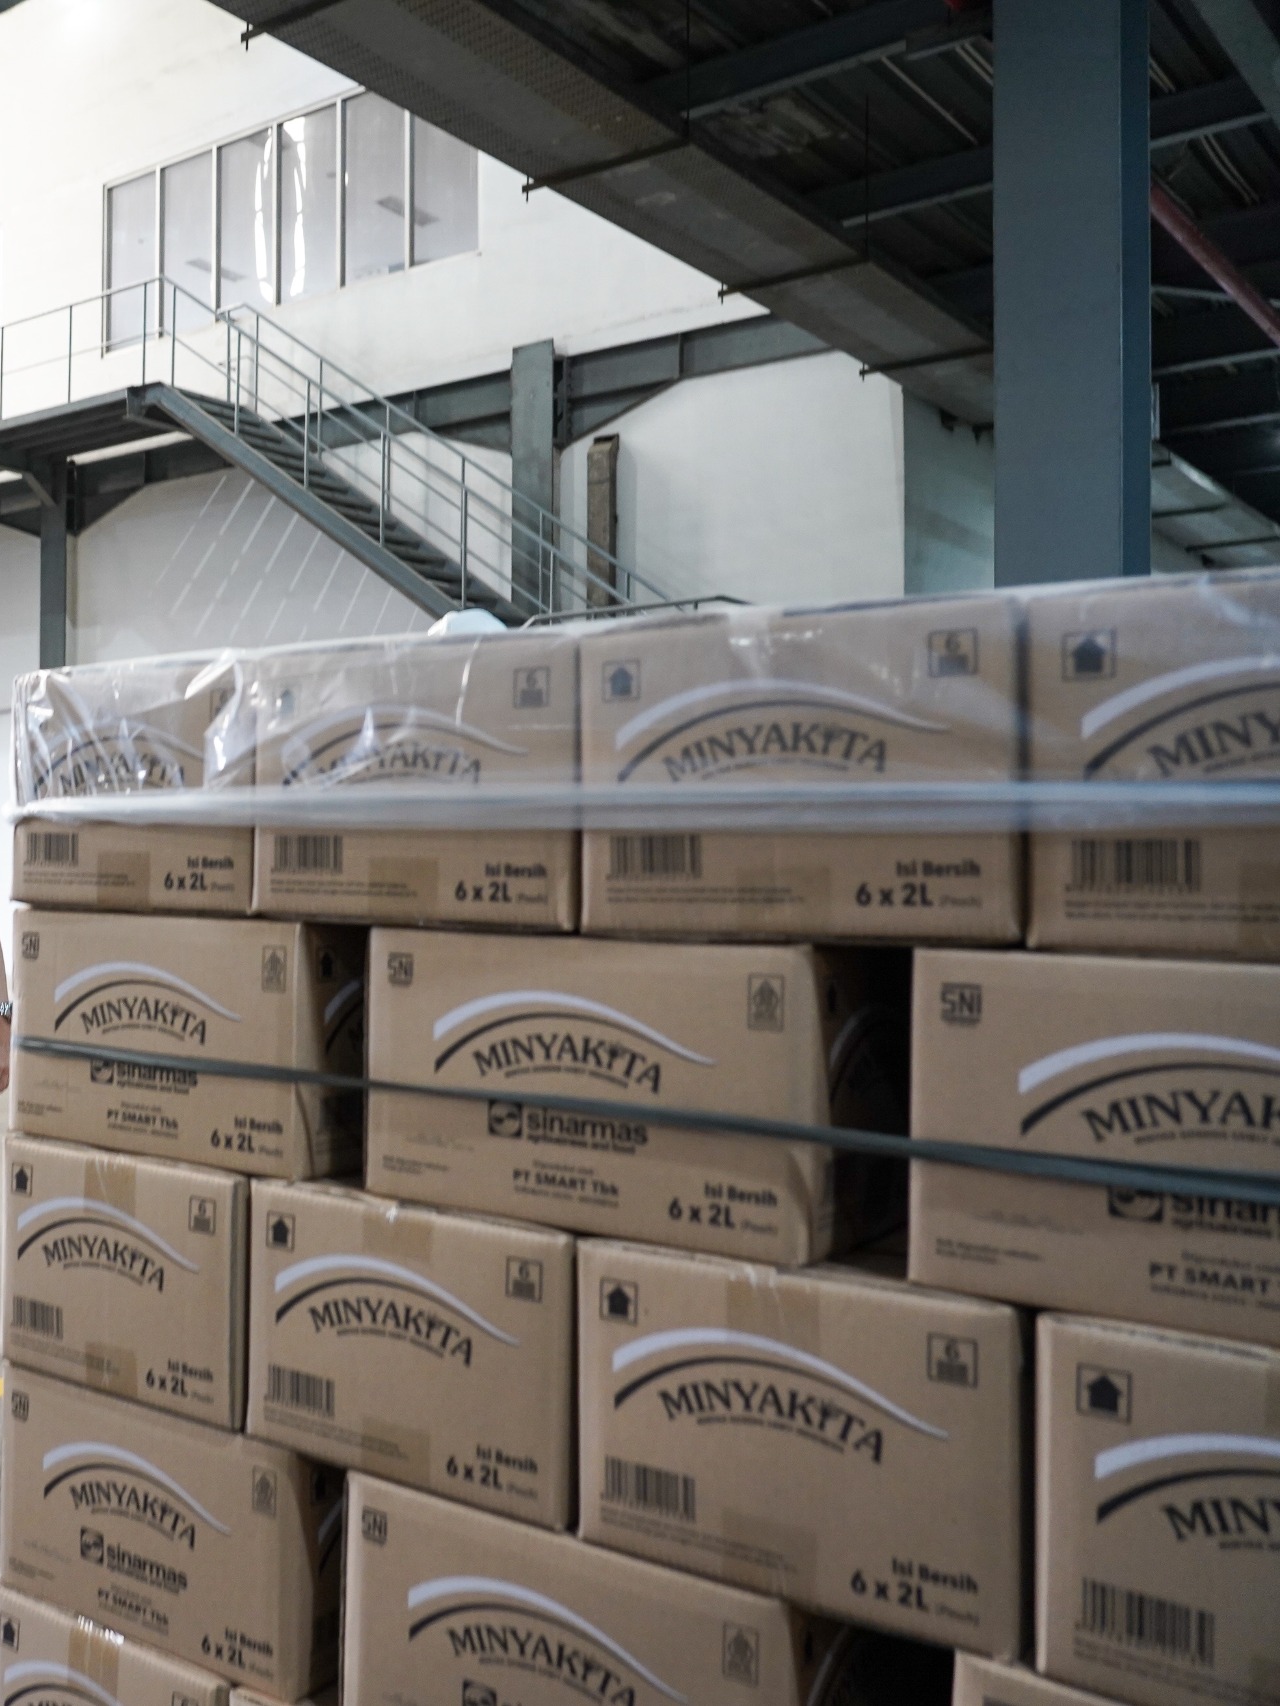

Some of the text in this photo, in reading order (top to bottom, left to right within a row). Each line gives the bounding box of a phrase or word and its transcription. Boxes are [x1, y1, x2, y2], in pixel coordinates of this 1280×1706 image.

[663, 720, 889, 784] MINYAKITA
[202, 856, 235, 870] Bersih
[505, 864, 547, 879] Bersih
[923, 861, 982, 878] Bersih
[164, 871, 175, 890] 6
[177, 875, 186, 890] x
[189, 870, 207, 890] 2L
[454, 881, 467, 901] 6
[472, 884, 483, 901] x
[489, 881, 512, 902] 2L
[856, 884, 871, 907] 6
[879, 889, 893, 908] x
[901, 883, 934, 907] 2L
[941, 984, 982, 1022] SNI
[80, 995, 206, 1045] MINYAKITA
[472, 1032, 661, 1094] MINYAKITA
[122, 1110, 156, 1126] SMART
[250, 1116, 283, 1135] Bersih
[527, 1105, 648, 1145] sinarmas
[210, 1128, 220, 1147] 6
[224, 1134, 233, 1150] x
[237, 1131, 255, 1154] 2L
[513, 1169, 529, 1183] PT
[534, 1172, 586, 1193] SMART
[592, 1181, 618, 1197] Tbk
[727, 1186, 778, 1208] Bersih
[669, 1198, 682, 1221] 6
[689, 1206, 702, 1224] x
[709, 1204, 736, 1230] 2L
[41, 1234, 166, 1293] MINYAKITA
[1184, 1266, 1271, 1294] SMART
[308, 1297, 473, 1368] MINYAKITA
[146, 1368, 155, 1389] 6
[159, 1377, 167, 1392] x
[171, 1374, 189, 1398] 2L
[181, 1361, 213, 1382] Bersih
[658, 1380, 884, 1465] MINYAKITA
[446, 1456, 458, 1477] 6
[464, 1466, 476, 1483] x
[480, 1465, 503, 1491] 2L
[495, 1450, 539, 1474] Bersih
[70, 1480, 196, 1551] MINYAKITA
[363, 1511, 388, 1540] SNI
[107, 1543, 188, 1590] sinarmas
[918, 1565, 979, 1594] Bersih
[850, 1569, 867, 1596] 6
[875, 1583, 889, 1602] x
[897, 1581, 929, 1611] 2L
[113, 1595, 146, 1616] SMART
[202, 1634, 211, 1653] 6
[228, 1645, 246, 1669] 2L
[240, 1632, 273, 1658] Bersih
